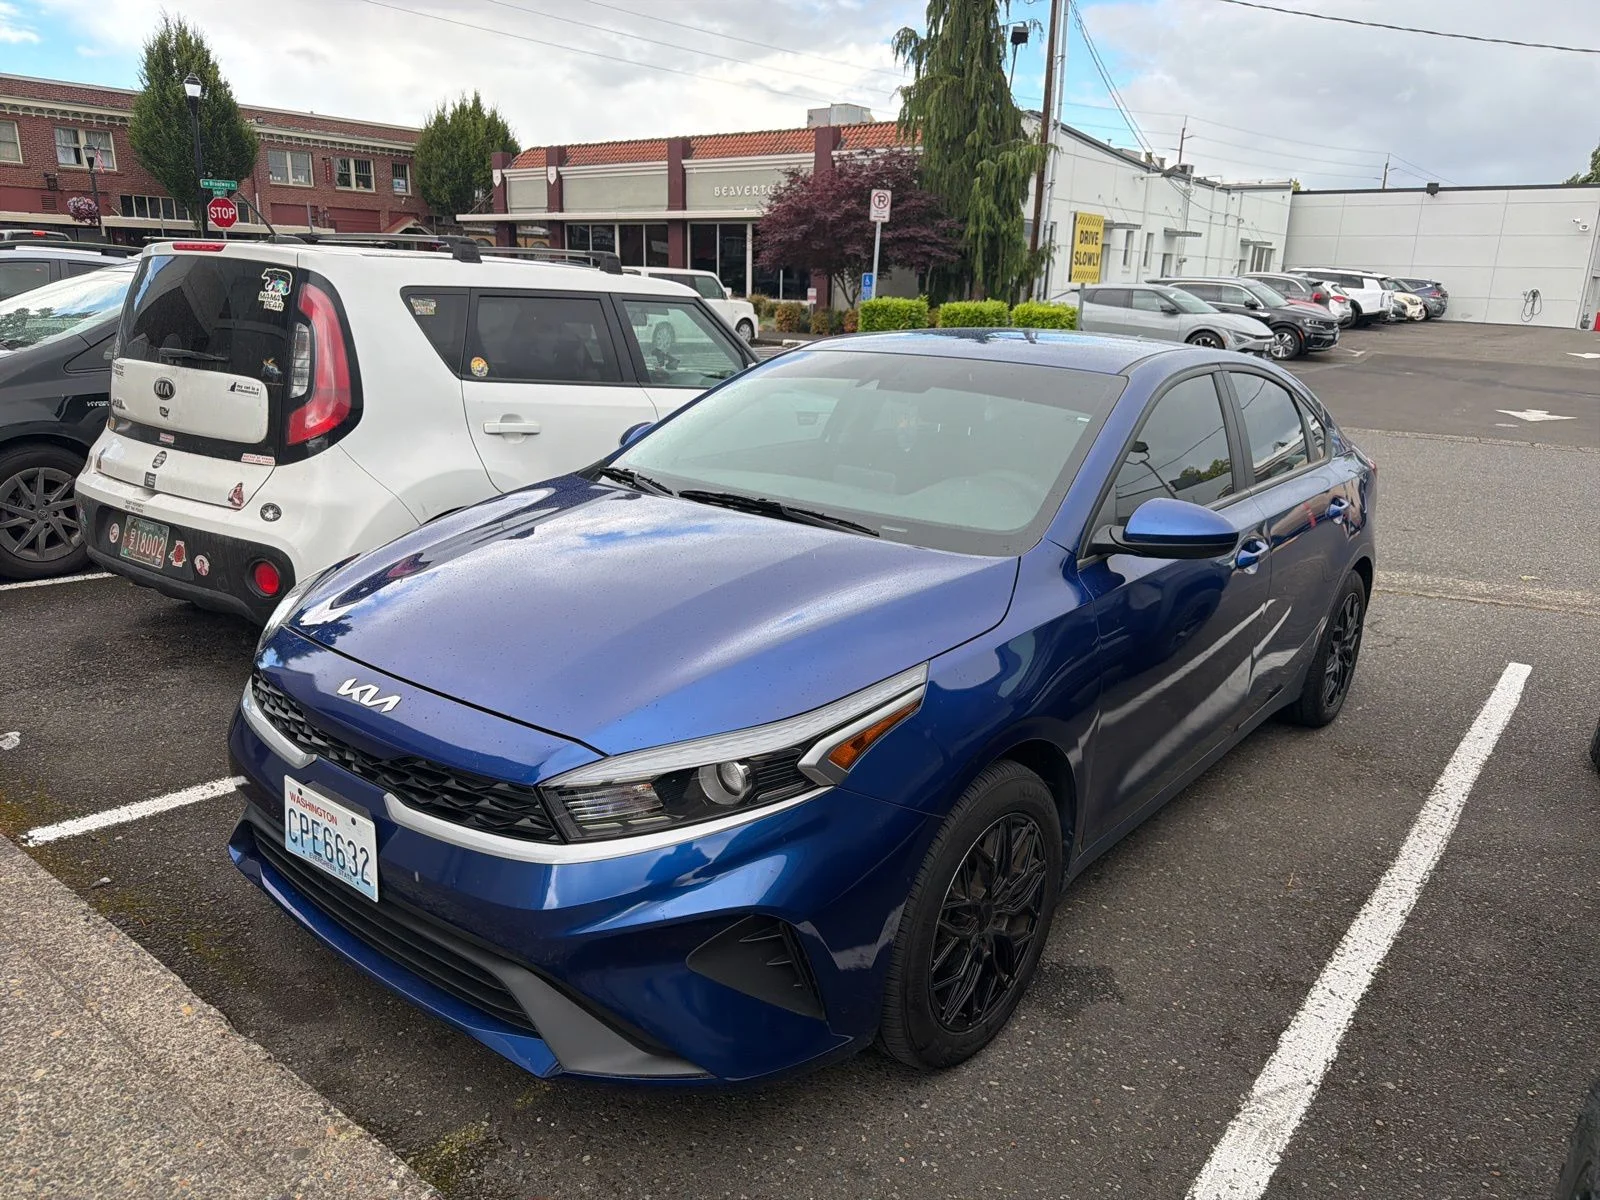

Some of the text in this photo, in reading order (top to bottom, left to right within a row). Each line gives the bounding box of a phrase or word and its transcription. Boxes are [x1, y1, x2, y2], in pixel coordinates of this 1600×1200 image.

[714, 184, 784, 196] BEAVERTO
[210, 206, 235, 219] STOP
[1079, 229, 1099, 246] DRIVE
[1074, 251, 1100, 267] SLOWLY
[259, 291, 282, 301] MAMA
[155, 381, 171, 396] KIA
[336, 677, 403, 713] KIA
[289, 790, 338, 826] WASHINGTON
[288, 807, 371, 887] CPE6632
[308, 851, 354, 882] EVERGREEN STATE
